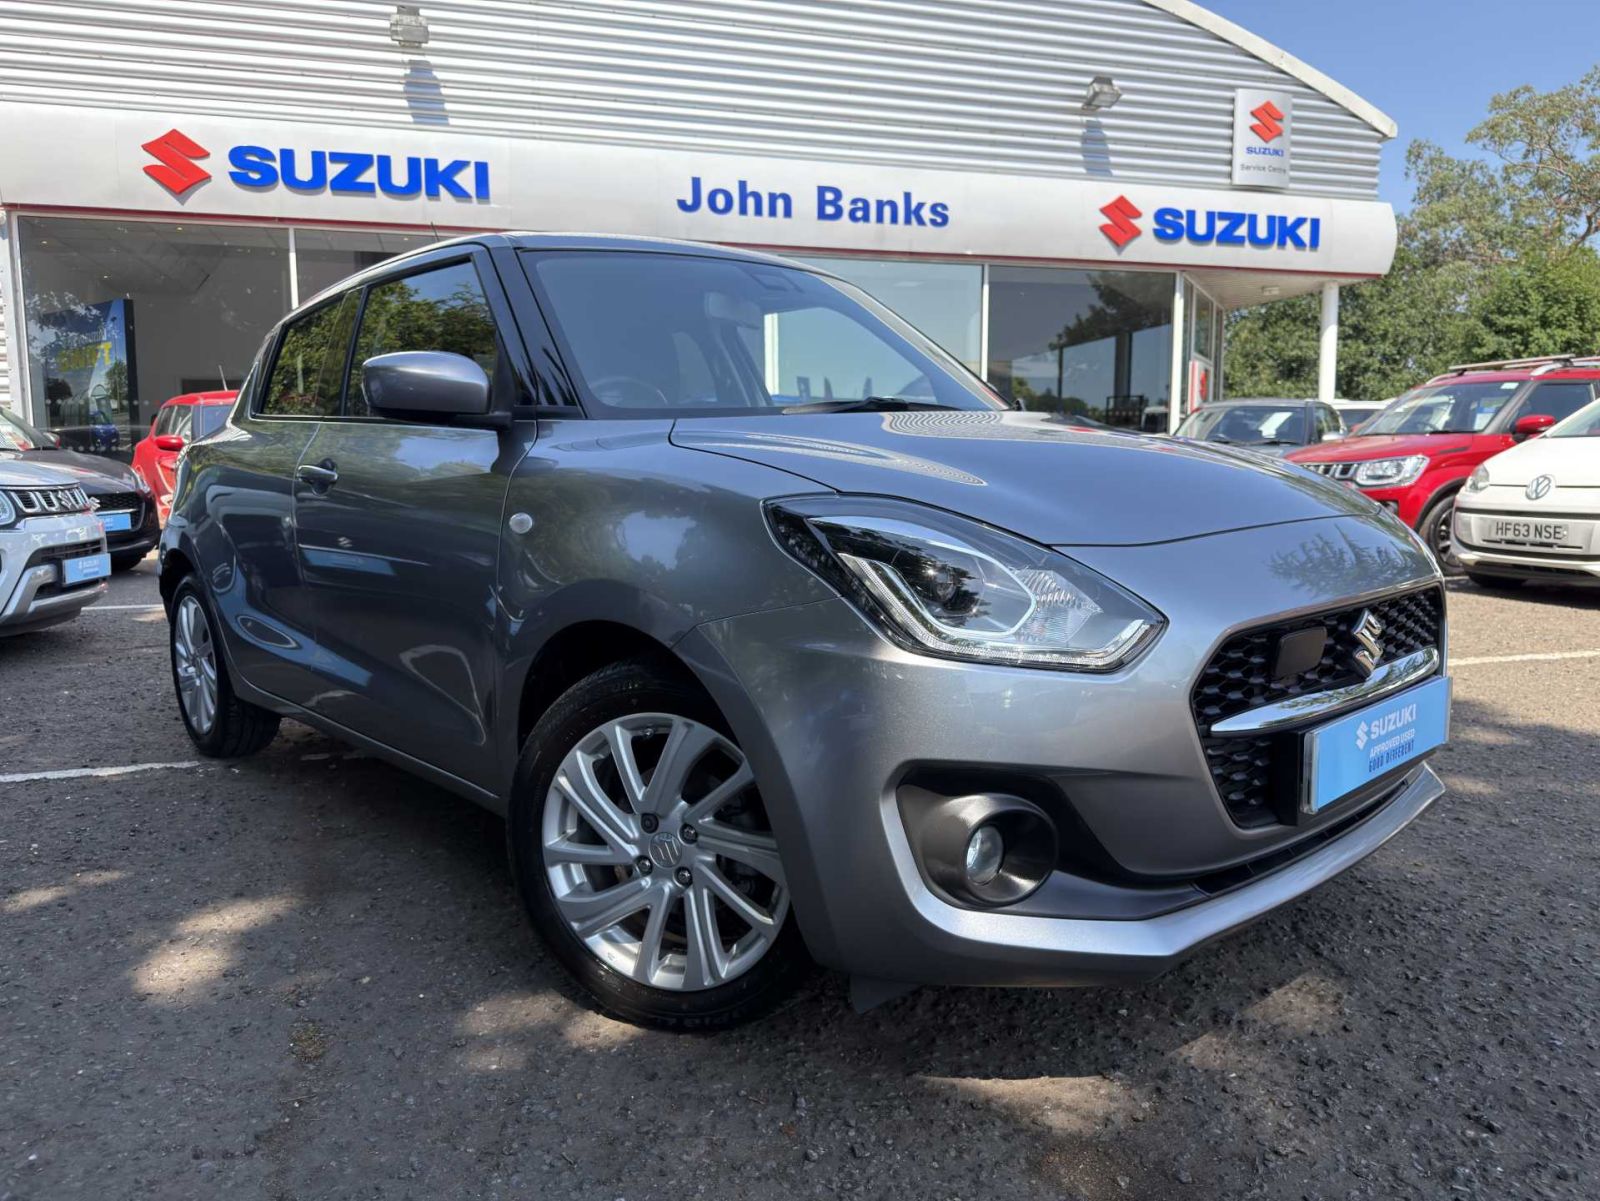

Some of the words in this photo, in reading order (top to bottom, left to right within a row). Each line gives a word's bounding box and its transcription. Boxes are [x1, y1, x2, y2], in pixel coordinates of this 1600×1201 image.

[1240, 163, 1266, 172] Service
[1246, 146, 1285, 157] SUZUKI
[228, 145, 489, 201] SUZUKI
[676, 176, 793, 219] John
[816, 185, 950, 228] Banks
[1153, 208, 1320, 249] SUZUKI
[1495, 521, 1530, 538] HF63
[1534, 524, 1563, 540] NSE
[1371, 704, 1416, 739] SUZUKI
